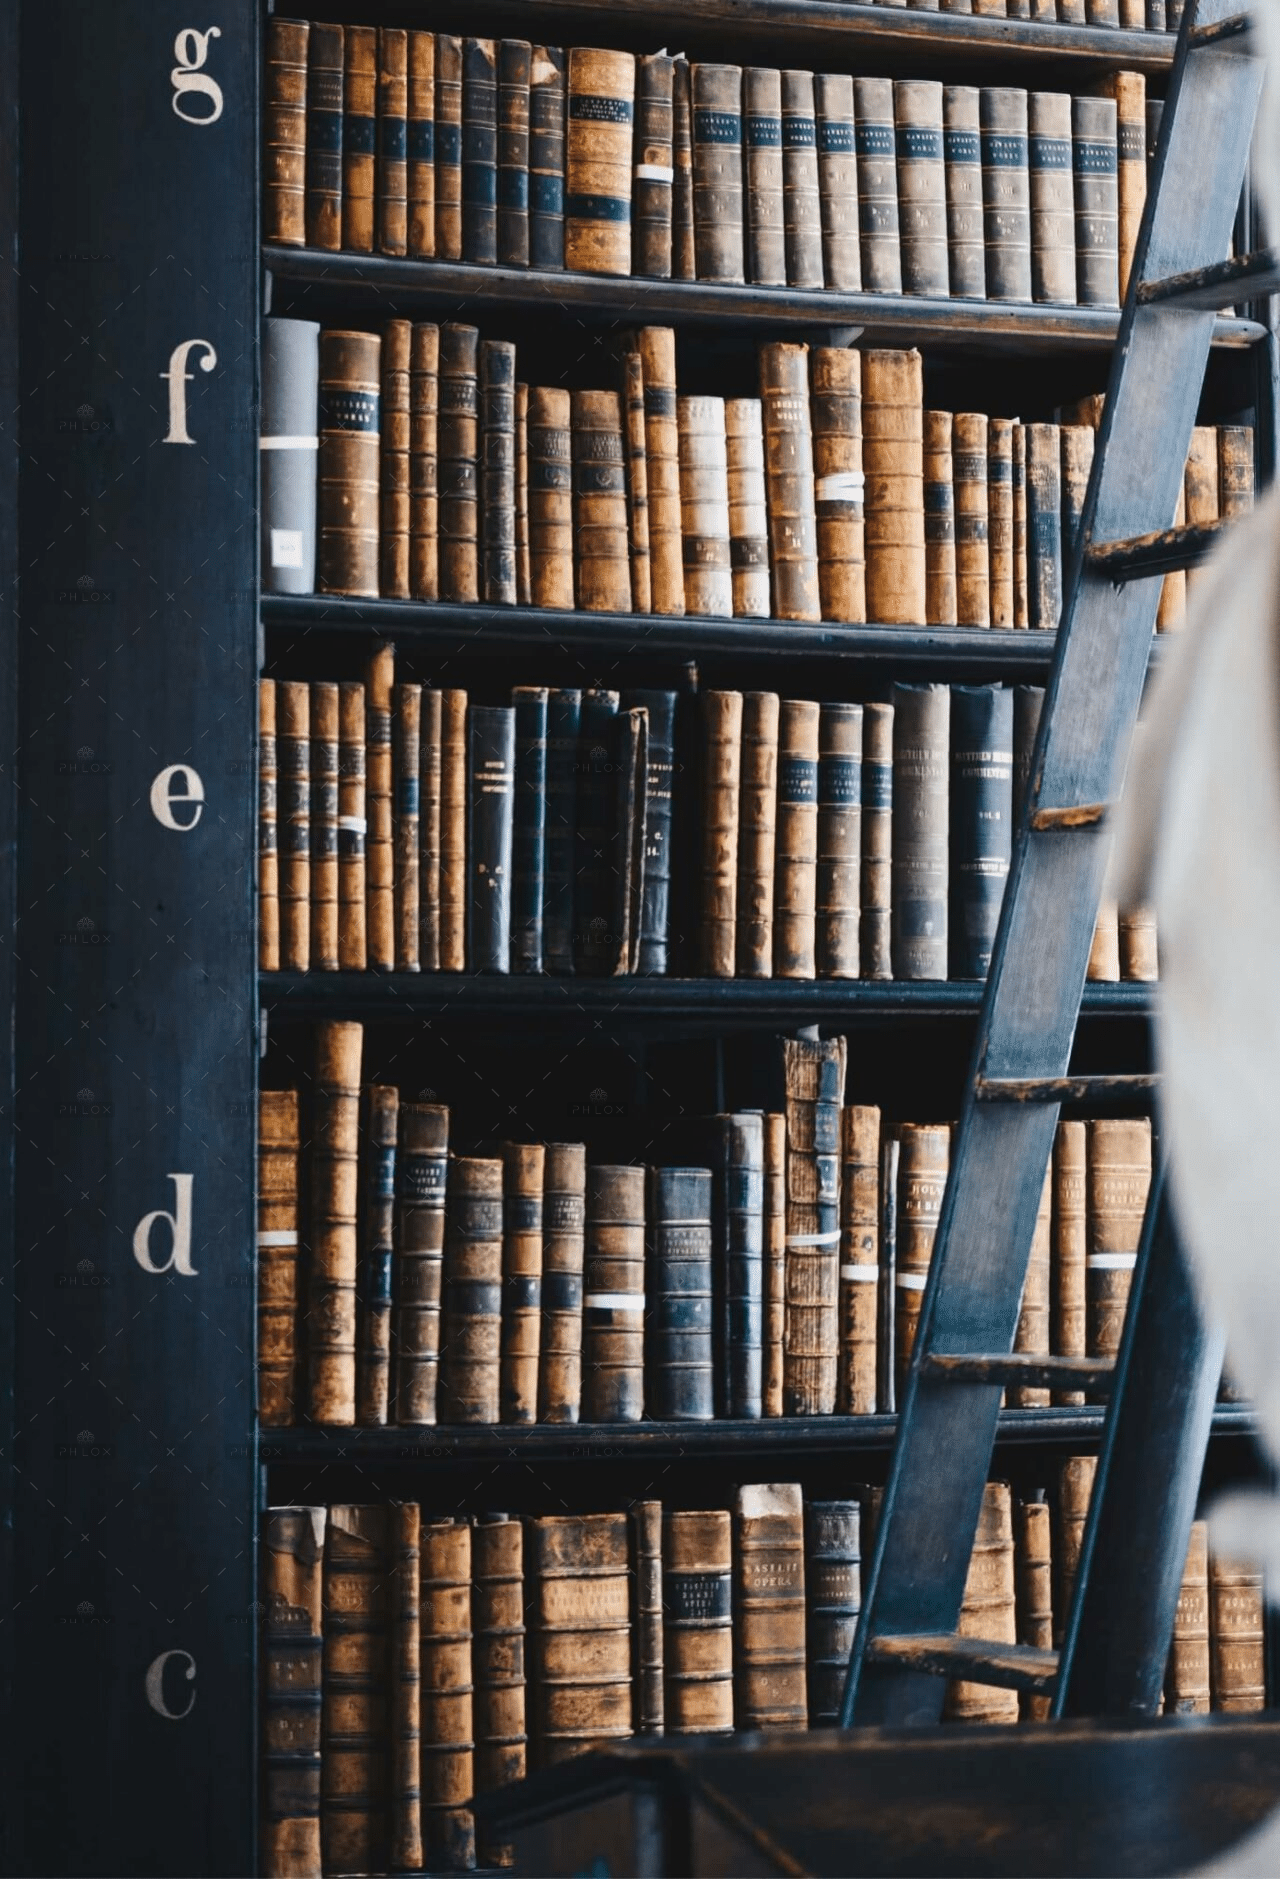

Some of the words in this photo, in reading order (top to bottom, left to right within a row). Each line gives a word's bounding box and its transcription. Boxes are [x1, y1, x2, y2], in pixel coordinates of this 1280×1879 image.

[170, 25, 224, 126] g
[159, 338, 218, 445] f
[149, 763, 205, 832] e
[131, 1173, 199, 1276] d
[146, 1649, 198, 1721] c
